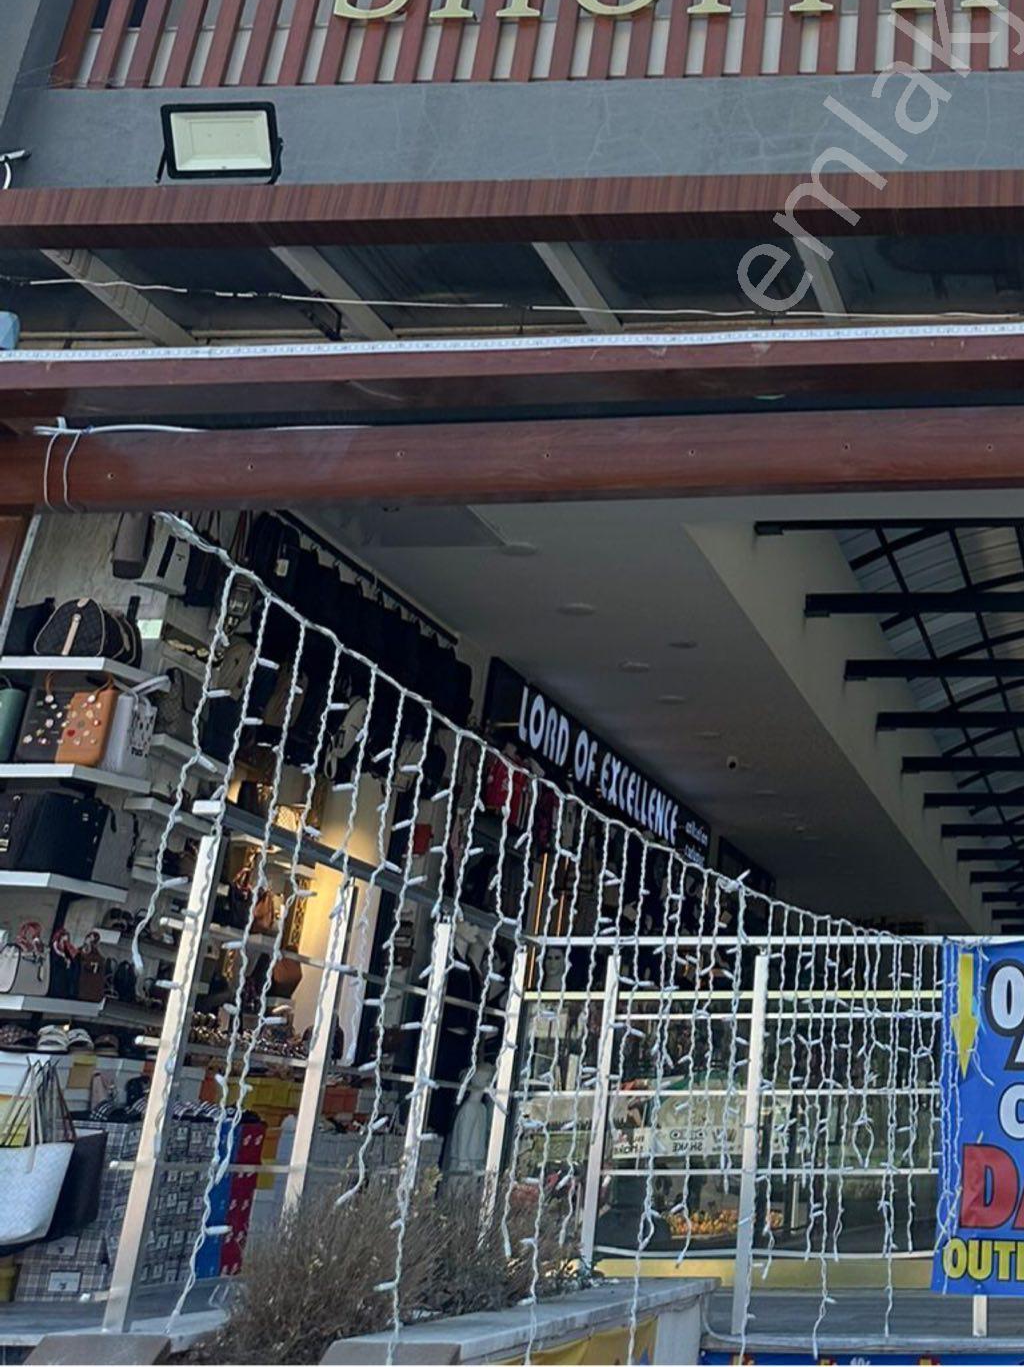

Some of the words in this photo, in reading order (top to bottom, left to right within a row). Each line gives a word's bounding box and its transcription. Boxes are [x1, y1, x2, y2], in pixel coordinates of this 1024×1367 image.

[518, 685, 570, 767] LORD
[574, 730, 598, 786] OF
[602, 752, 679, 845] EXCELLENCE
